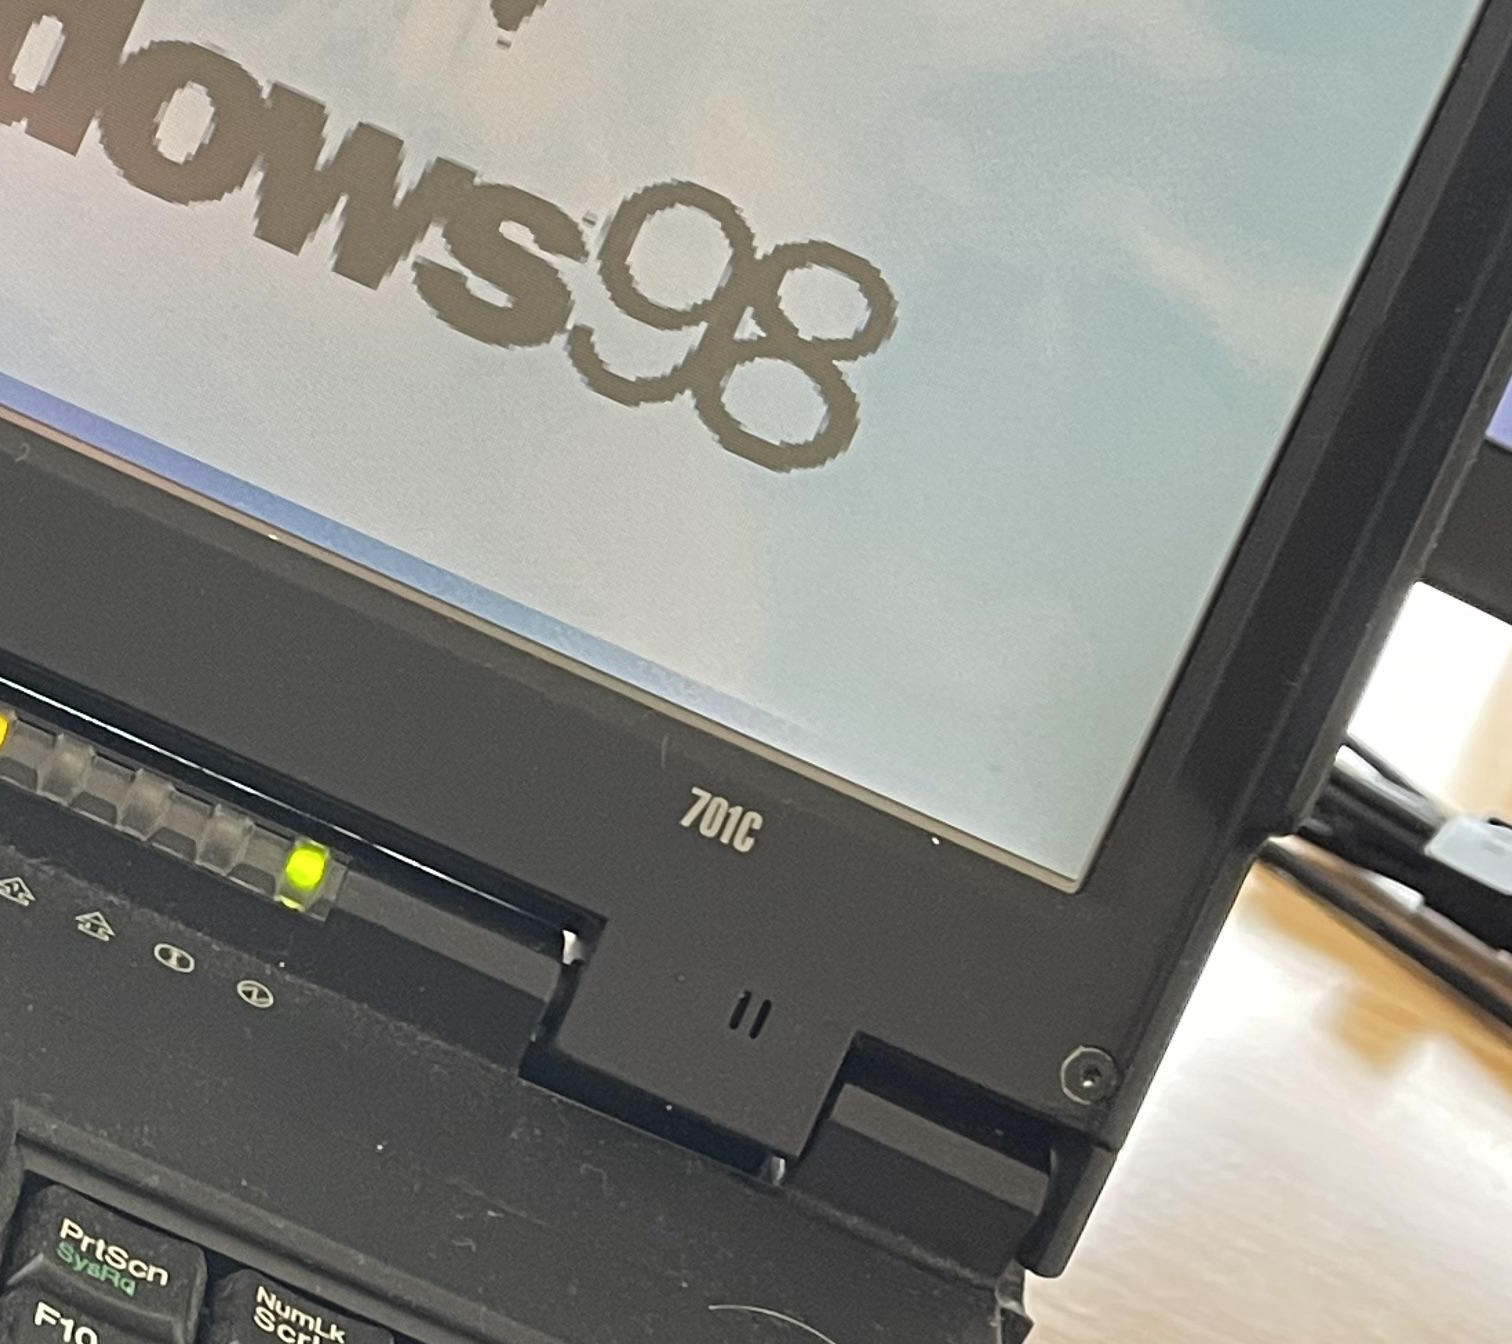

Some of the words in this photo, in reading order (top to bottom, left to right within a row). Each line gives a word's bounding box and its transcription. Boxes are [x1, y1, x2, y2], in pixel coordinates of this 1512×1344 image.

[680, 787, 763, 853] 701C
[60, 1217, 169, 1286] PrtScn
[256, 1285, 347, 1344] NumLk
